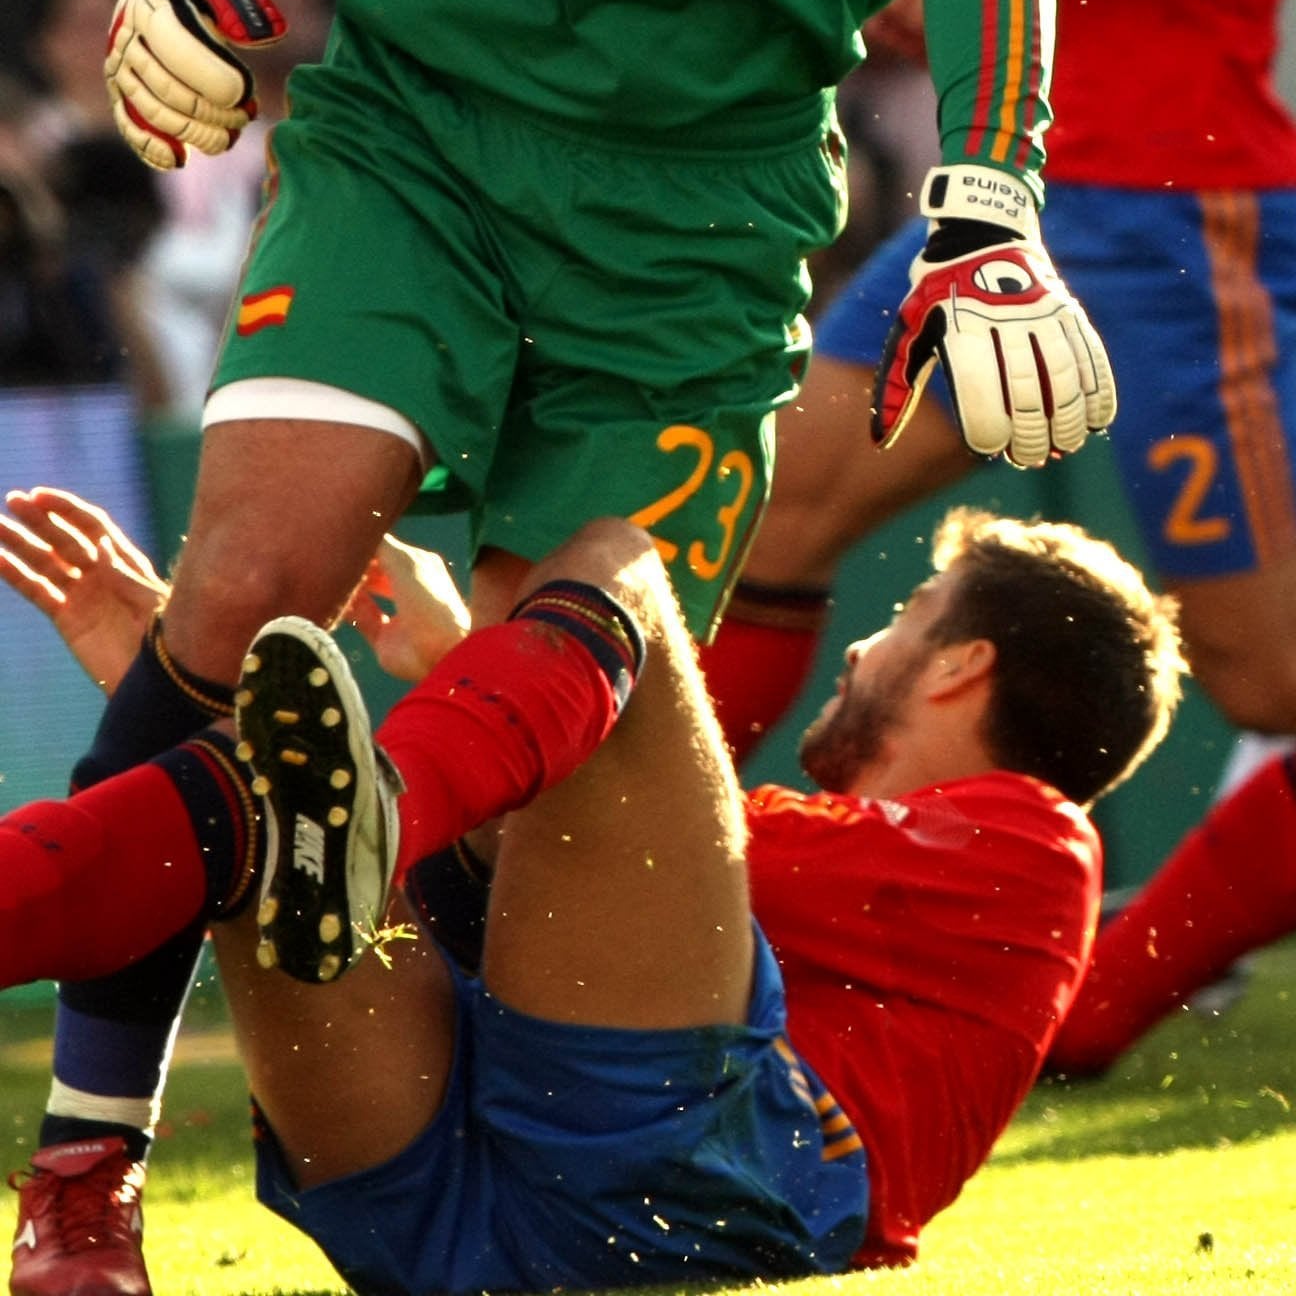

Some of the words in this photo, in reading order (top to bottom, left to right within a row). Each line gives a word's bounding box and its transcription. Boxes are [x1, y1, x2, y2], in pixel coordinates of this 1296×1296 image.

[963, 176, 1027, 208] Reina
[967, 194, 1018, 218] Pepe
[628, 424, 753, 580] 23
[1147, 435, 1230, 544] 2
[294, 812, 325, 885] NIKE
